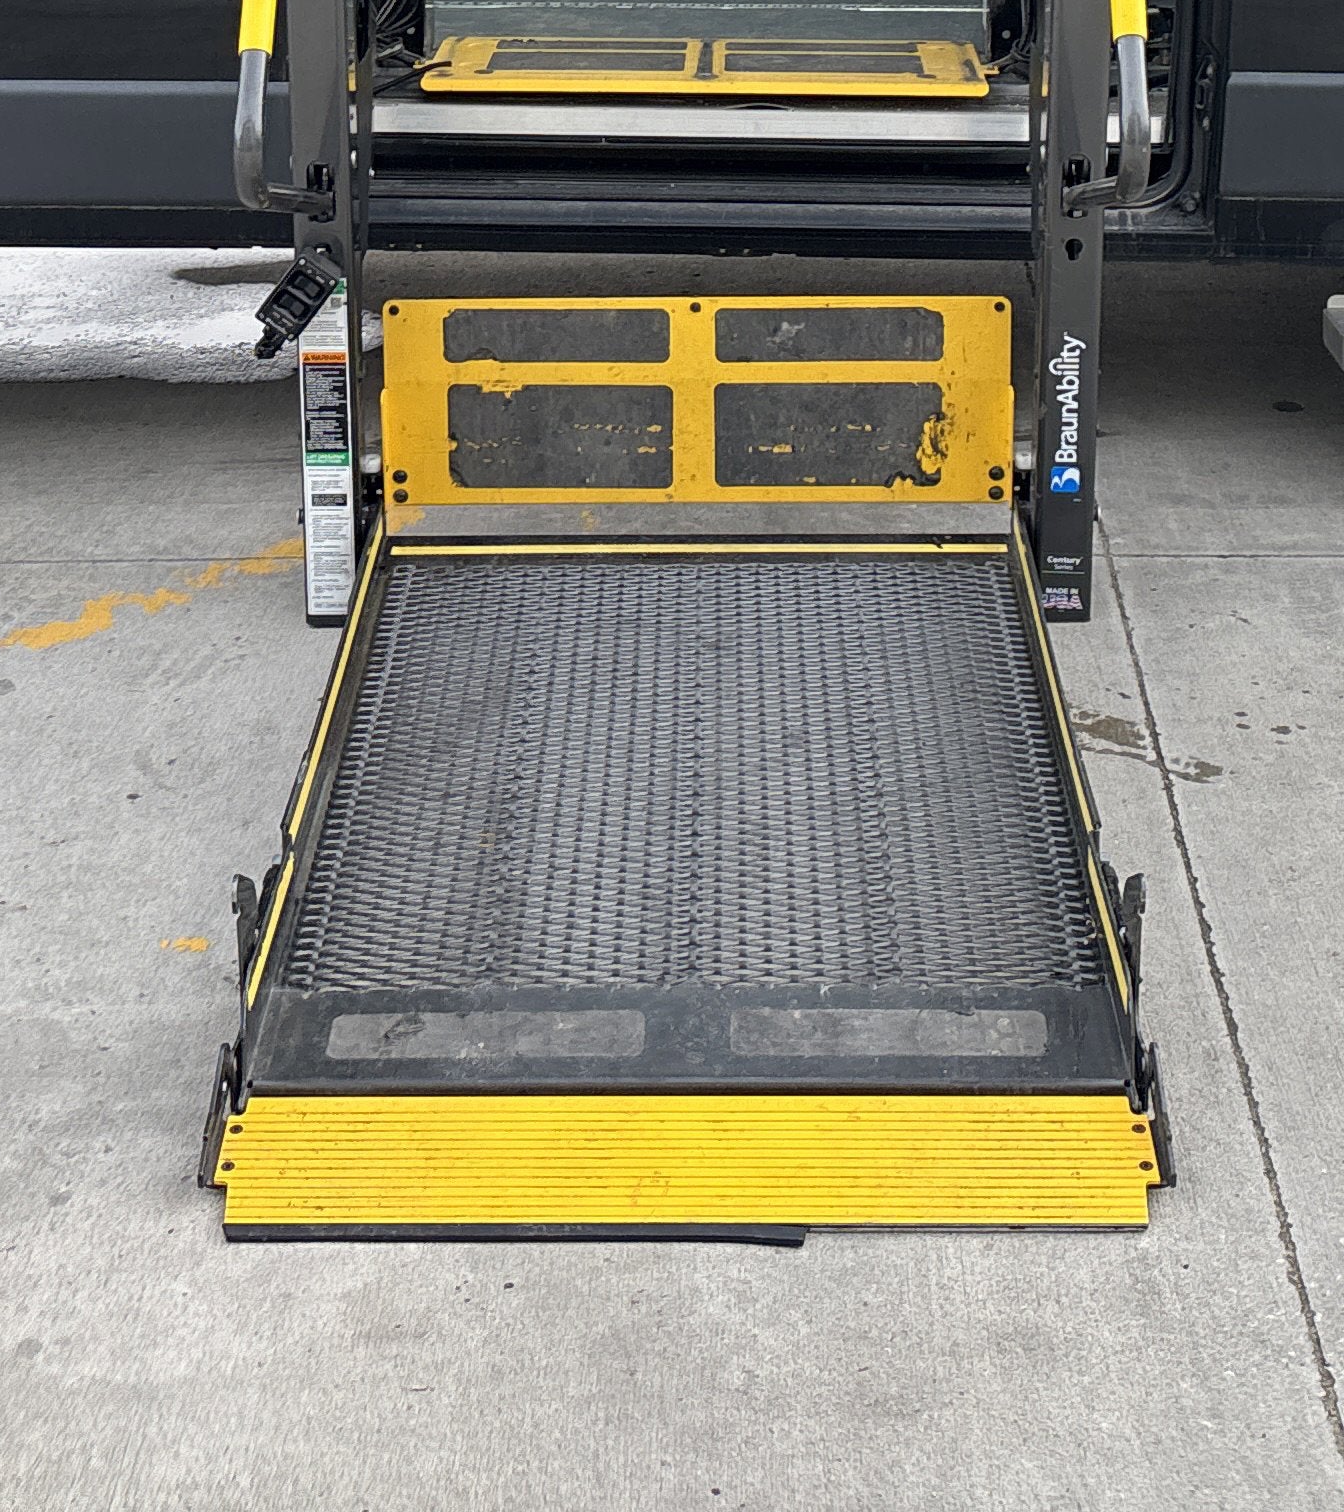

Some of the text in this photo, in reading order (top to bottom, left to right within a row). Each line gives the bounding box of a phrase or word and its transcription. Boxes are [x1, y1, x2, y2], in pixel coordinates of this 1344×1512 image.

[1049, 334, 1087, 463] BraunAbility
[1047, 555, 1081, 566] Century
[1041, 593, 1084, 610] USA
